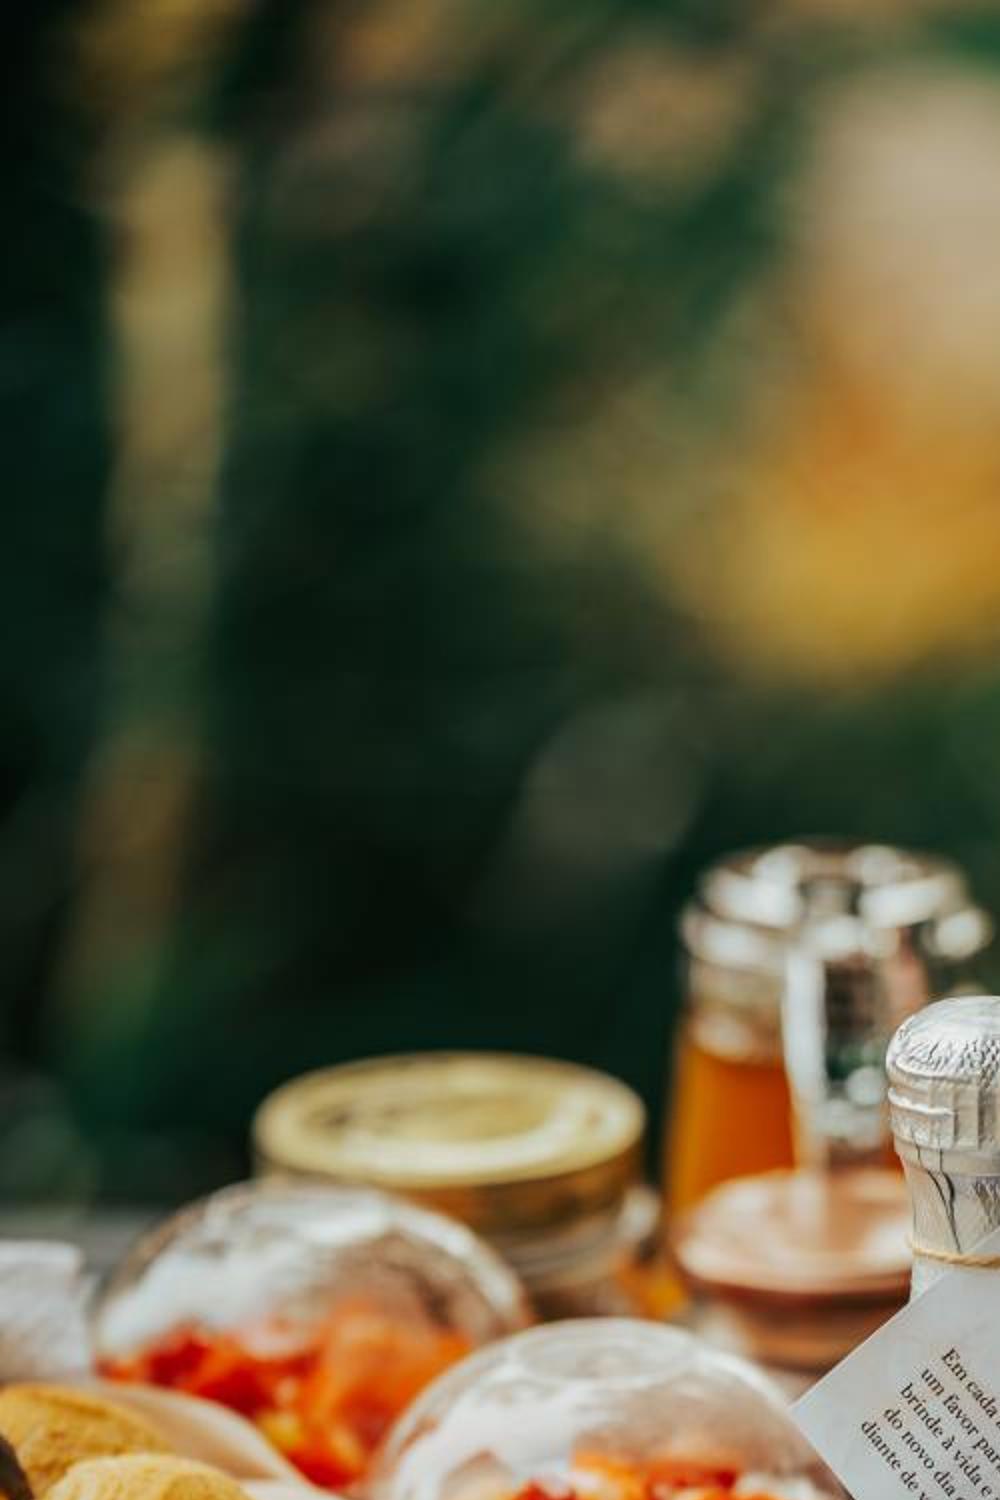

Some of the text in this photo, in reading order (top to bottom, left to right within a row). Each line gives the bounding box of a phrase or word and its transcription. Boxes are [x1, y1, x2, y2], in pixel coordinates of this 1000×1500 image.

[921, 1368, 945, 1397] um
[942, 1393, 980, 1437] favor
[941, 1347, 968, 1382] Em
[965, 1381, 998, 1419] cada
[861, 1421, 901, 1471] diante
[899, 1471, 919, 1492] de
[882, 1408, 903, 1431] do
[900, 1430, 935, 1470] novo
[933, 1471, 958, 1498] dia
[899, 1381, 944, 1439] brinde
[941, 1434, 956, 1451] à
[953, 1449, 983, 1487] vida
[980, 1485, 993, 1498] e
